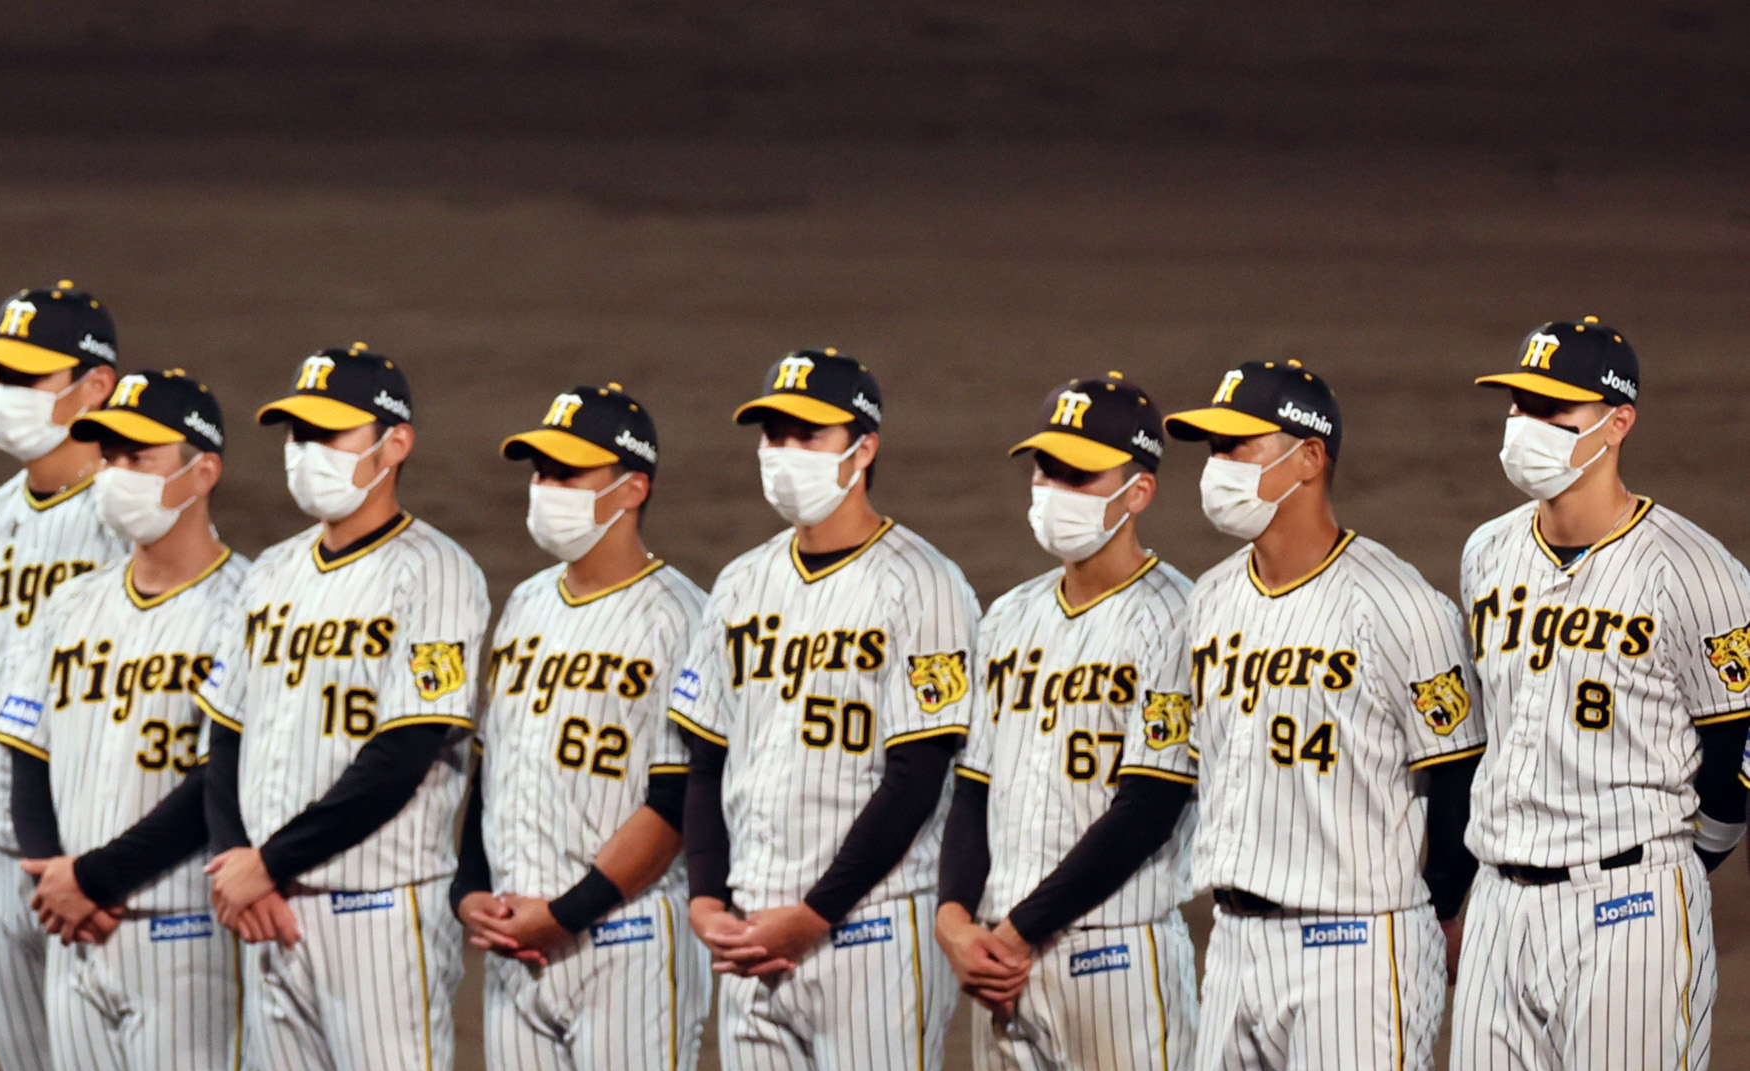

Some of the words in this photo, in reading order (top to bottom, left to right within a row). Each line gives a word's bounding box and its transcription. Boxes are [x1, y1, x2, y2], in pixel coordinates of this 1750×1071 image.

[1277, 400, 1333, 437] Joshin
[245, 603, 397, 689] Tigers
[726, 612, 887, 704] Tigers
[1470, 584, 1656, 674] Tigers
[50, 639, 214, 723] Tigers
[487, 634, 655, 716] Tigers
[986, 647, 1139, 735] Tigers
[1191, 631, 1358, 716] Tigers
[1574, 677, 1614, 732] 8
[321, 681, 378, 740] 16
[801, 694, 875, 756] 50
[556, 716, 631, 780] 62
[1065, 729, 1126, 787] 67
[1269, 713, 1338, 775] 94
[594, 918, 652, 942] Joshin
[834, 918, 891, 945] Joshin
[1303, 923, 1367, 945] Joshin
[1596, 893, 1655, 924] Joshin
[1070, 947, 1129, 973] Joshin
